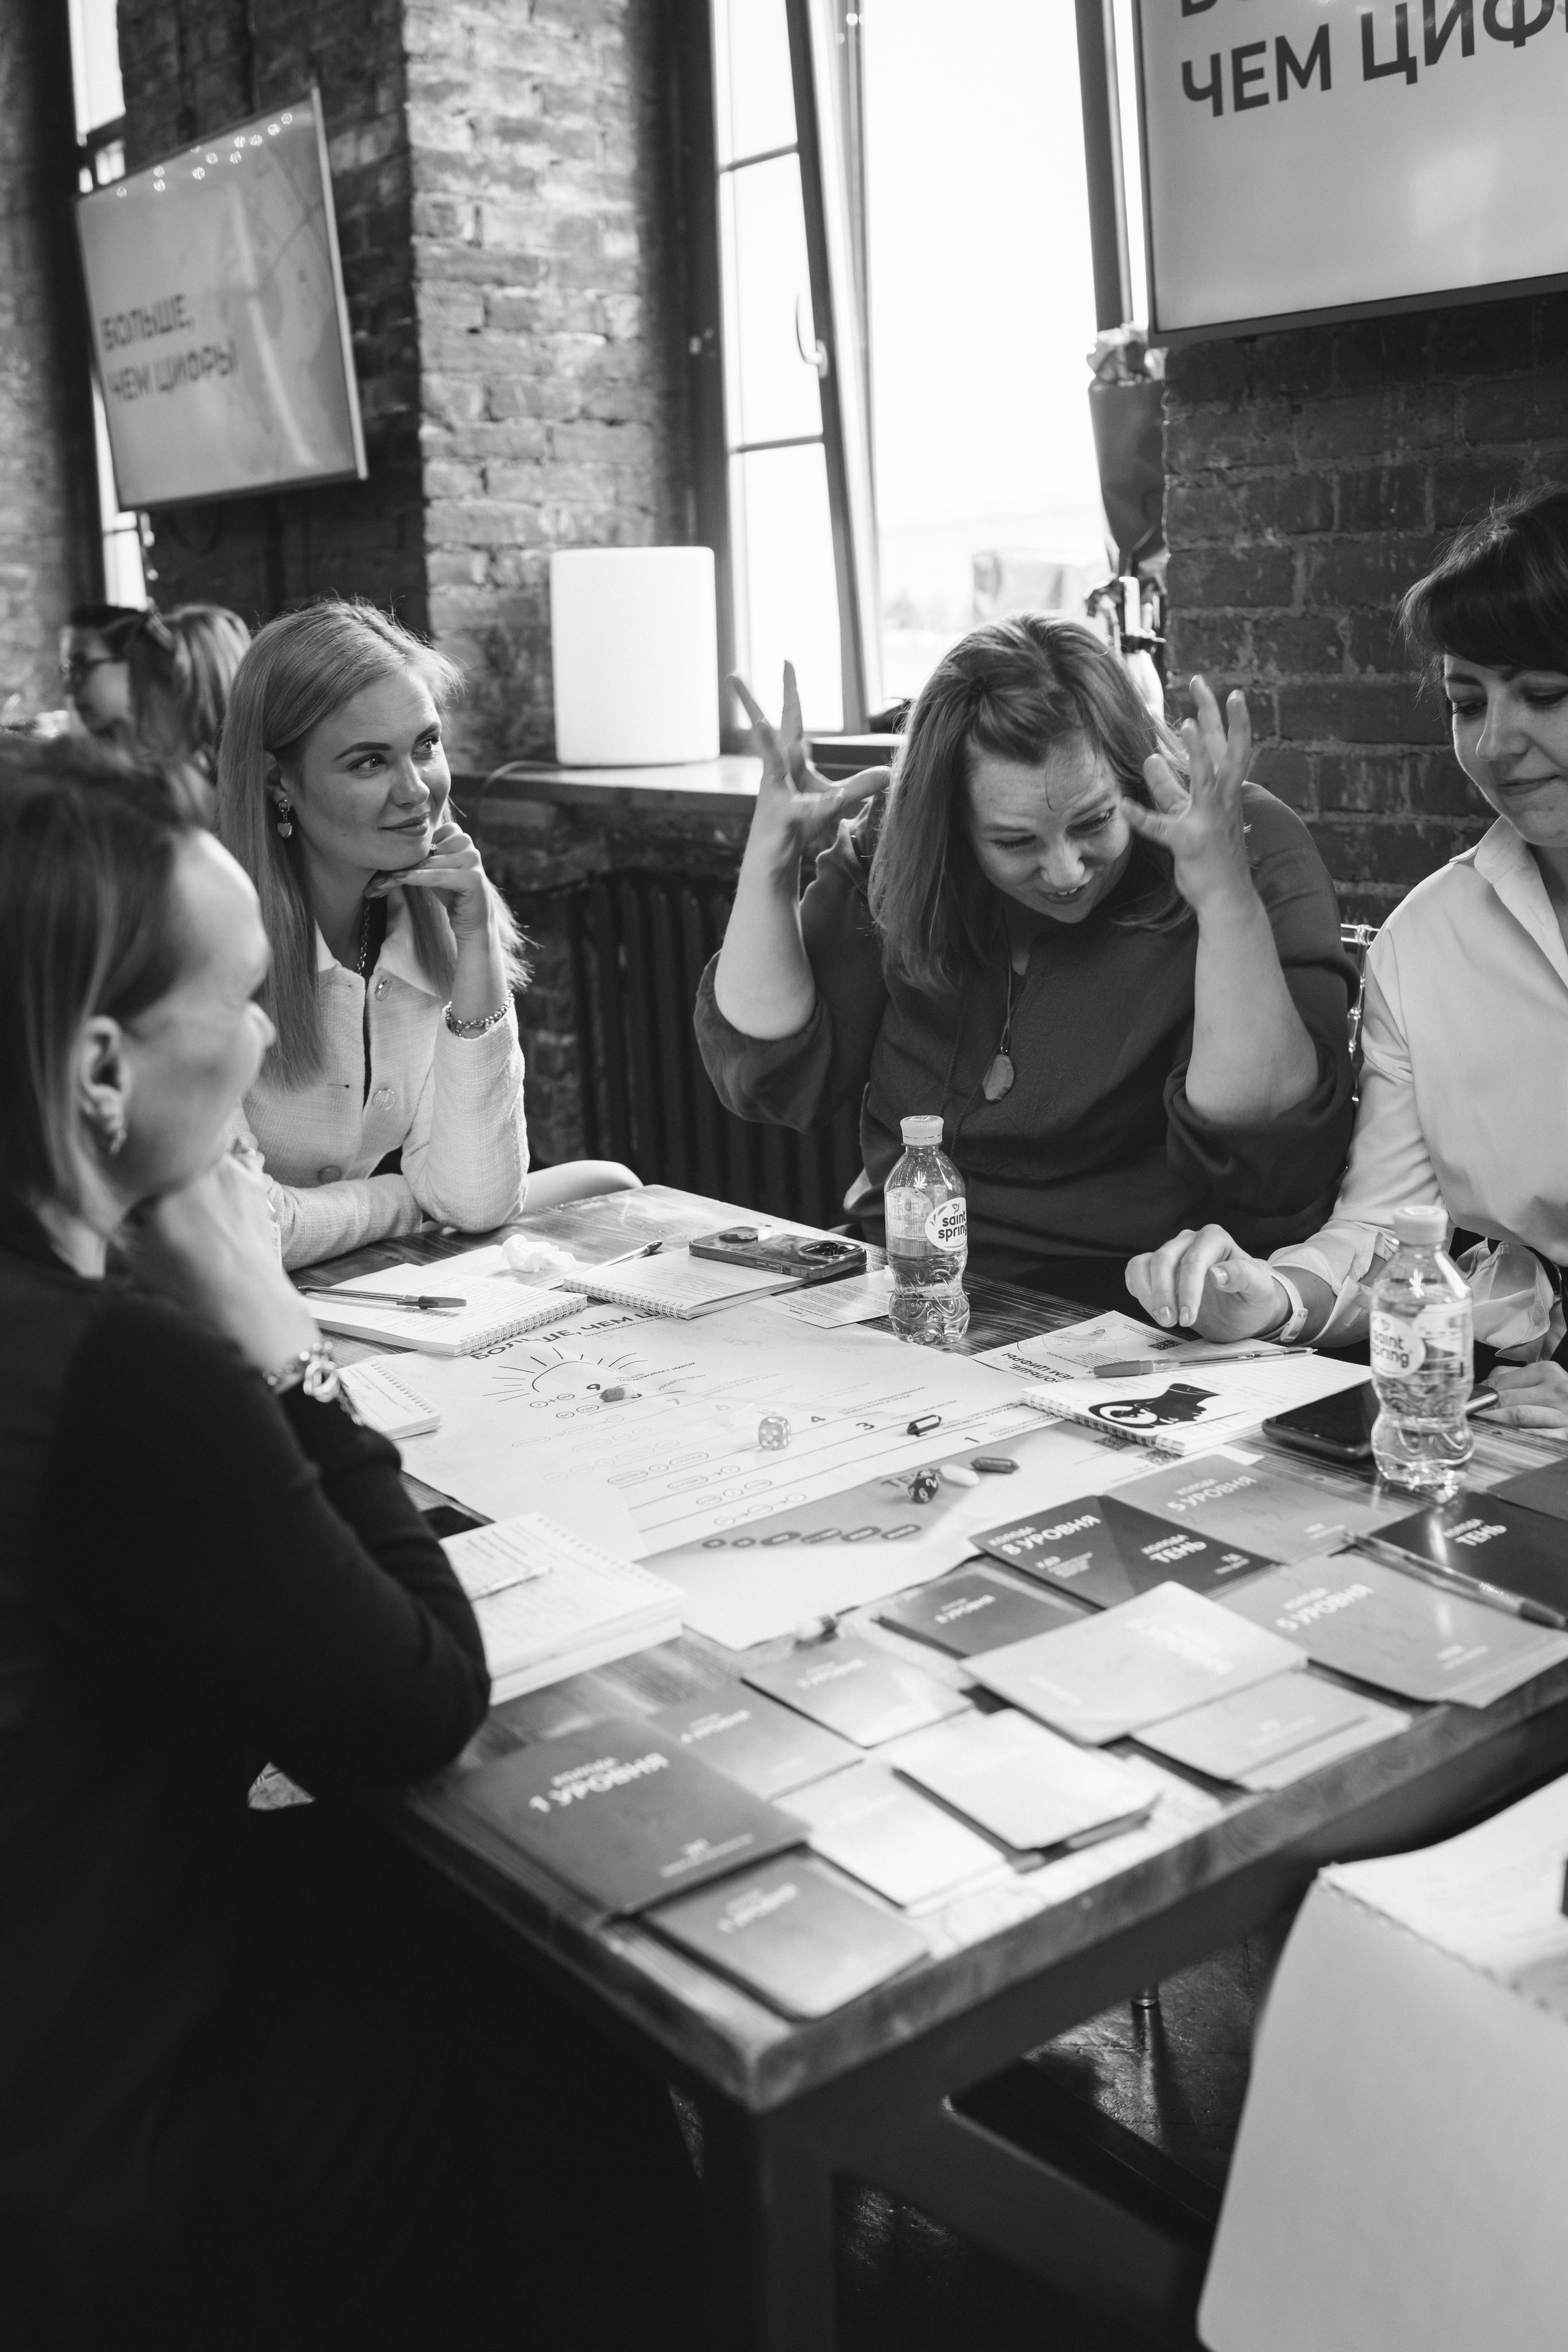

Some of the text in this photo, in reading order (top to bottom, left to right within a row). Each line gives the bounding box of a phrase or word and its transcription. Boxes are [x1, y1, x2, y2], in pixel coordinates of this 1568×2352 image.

[1182, 0, 1568, 118] ЧЕМ ЦИФ
[100, 294, 192, 352] БОЛЬШЕ,
[107, 337, 238, 402] ЧЕМ ЦИФРЫ
[942, 1210, 966, 1227] saint
[470, 1316, 633, 1360] БОЛЬШЕ, ЧЕМ
[1001, 1352, 1053, 1374] ЦИФРЫ
[855, 1422, 875, 1430] 3
[925, 1477, 938, 1488] 2
[1167, 1476, 1258, 1512] 5 УРОВНЯ
[1001, 1514, 1102, 1556] 8 УРОВНЯ
[1148, 1541, 1207, 1564] ТЕНЬ
[1454, 1525, 1507, 1547] ТЕНЬ
[1288, 1583, 1374, 1626] УРОВНЯ
[529, 1752, 670, 1814] 1 УРОВНЯ
